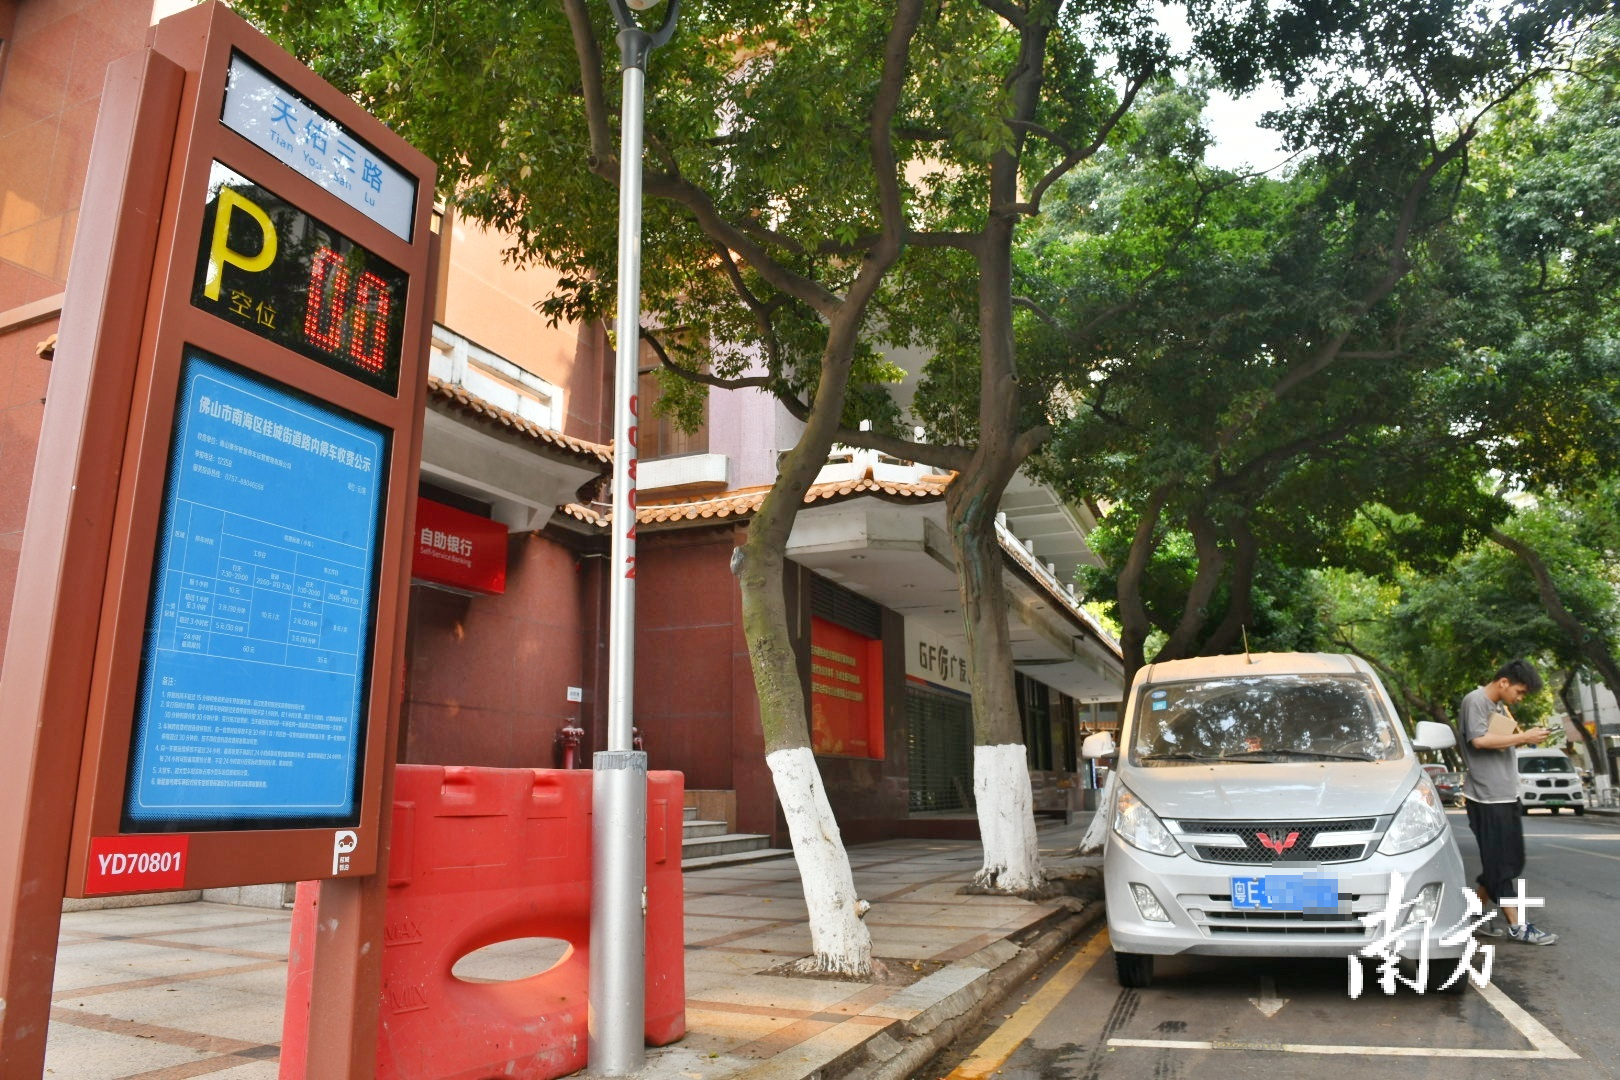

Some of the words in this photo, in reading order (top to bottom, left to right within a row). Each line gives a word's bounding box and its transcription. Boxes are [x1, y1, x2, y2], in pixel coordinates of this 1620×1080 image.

[269, 129, 294, 153] Tian
[334, 171, 352, 191] San
[364, 192, 376, 207] Lu
[270, 96, 383, 194] 天佑三路
[203, 184, 278, 302] P
[228, 289, 277, 330] 空位
[199, 395, 372, 473] 佛山市南海区桂城街道路内停车收费公示
[421, 527, 473, 557] 自助银行
[919, 641, 936, 671] GF
[98, 852, 181, 876] YD70801
